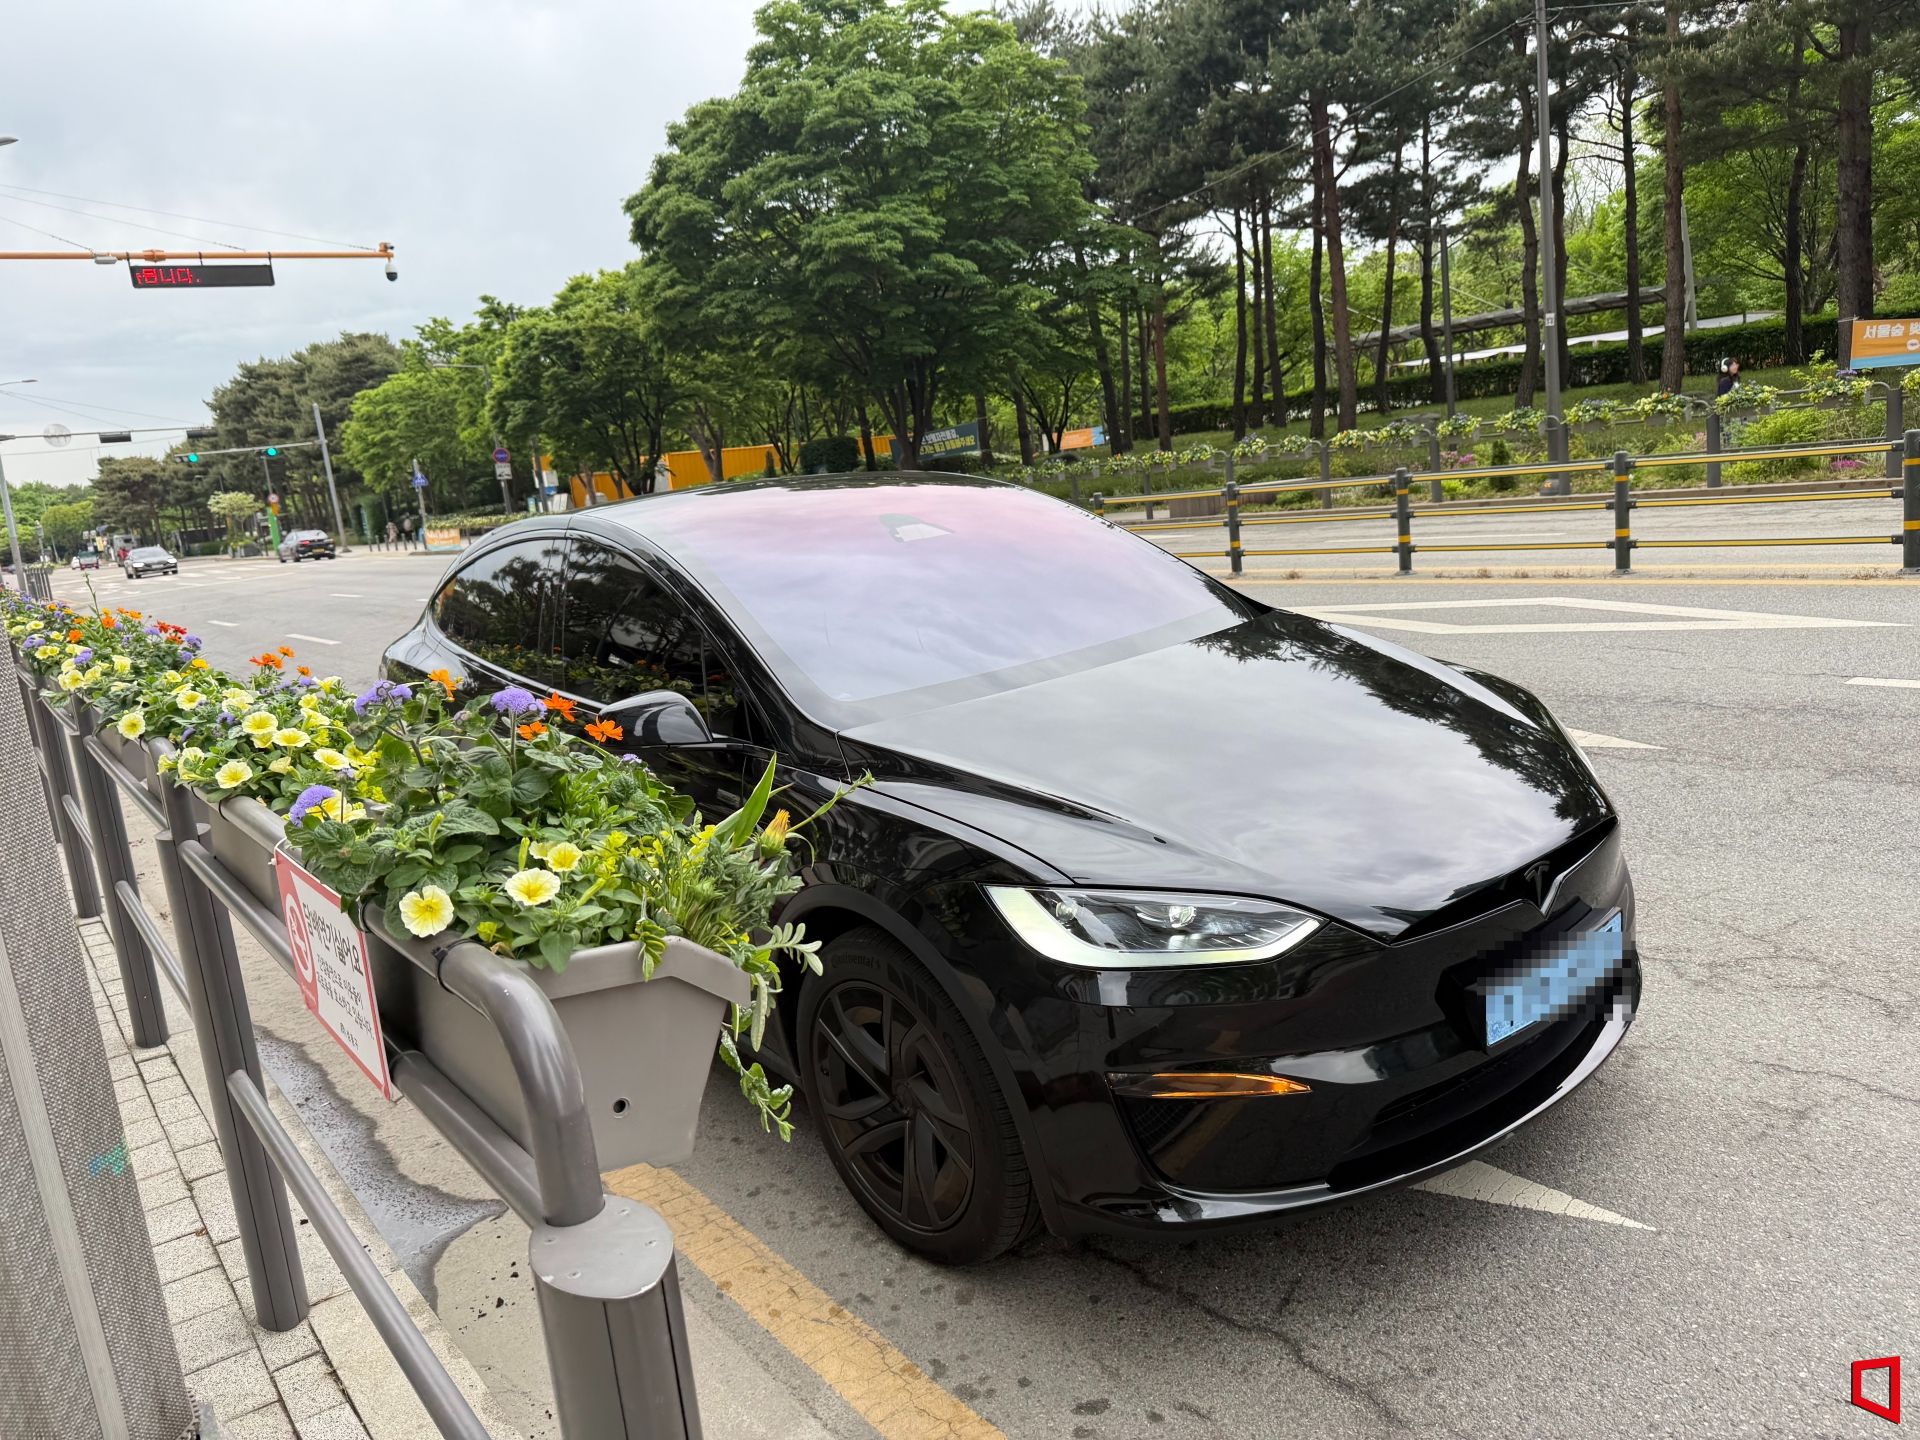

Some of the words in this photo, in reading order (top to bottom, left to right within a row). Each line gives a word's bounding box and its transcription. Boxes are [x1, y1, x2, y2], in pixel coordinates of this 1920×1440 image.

[1863, 323, 1905, 339] 서울숲
[832, 952, 873, 968] Continental
[317, 953, 344, 990] 간접흡연으로
[342, 977, 364, 1010] 이웃들이
[333, 985, 353, 1018] 호소하고
[352, 1006, 375, 1040] 있습니다.
